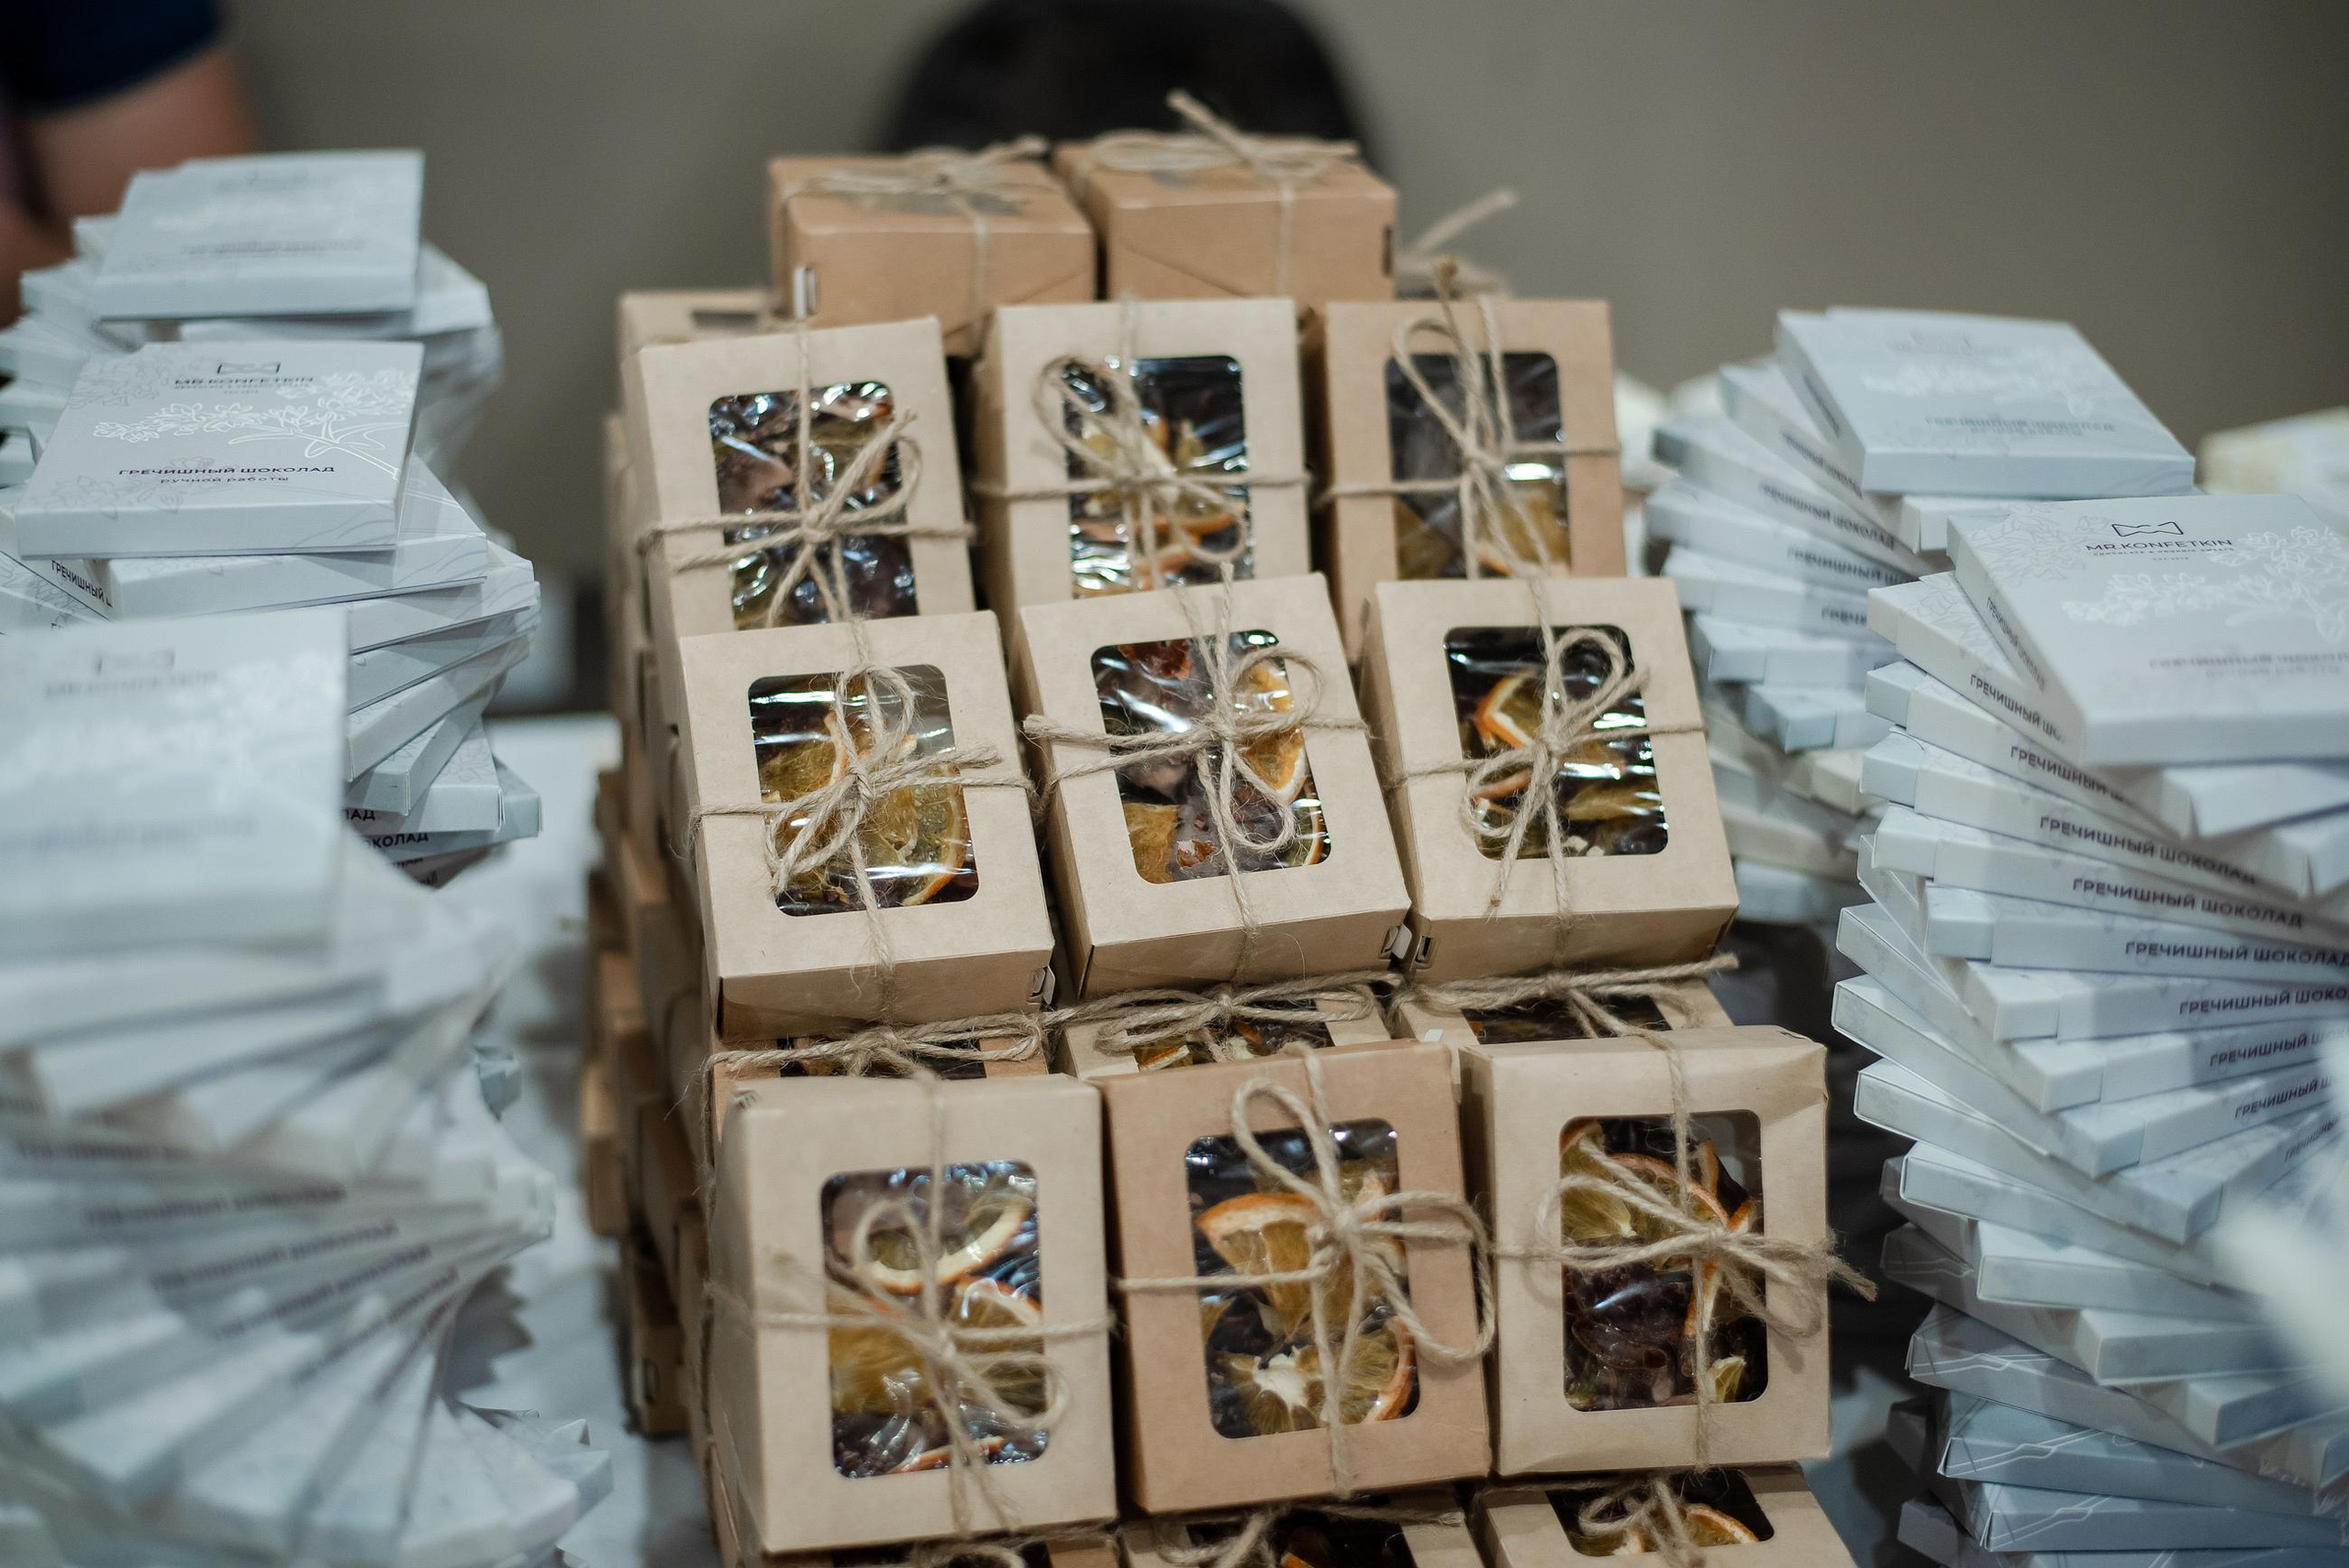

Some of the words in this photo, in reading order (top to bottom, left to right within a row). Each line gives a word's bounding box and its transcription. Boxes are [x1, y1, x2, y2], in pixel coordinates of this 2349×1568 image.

[119, 467, 236, 475] ГРЕЧИШНЫЙ
[2085, 539, 2232, 551] MR.KONFETKIN
[52, 560, 105, 603] ГРЕЧИШНЫЙ
[1970, 674, 2041, 727] ГРЕЧИШНЫЙ
[371, 832, 429, 849] КОЛАД
[2040, 816, 2154, 856] ГРЕЧИШНЫЙ
[2073, 878, 2195, 908] ГРЕЧИШНЫЙ
[2201, 898, 2303, 929] ШОКОЛАД
[2125, 941, 2248, 961] ГРЕЧИШНЫЙ
[2179, 989, 2290, 1015] ГРЕЧИШНЫЙ
[2295, 986, 2348, 1005] ШОКО
[2210, 1033, 2308, 1067] ГРЕЧИШНЫЙ
[2234, 1078, 2319, 1119] ГРЕЧИШНЫЙ
